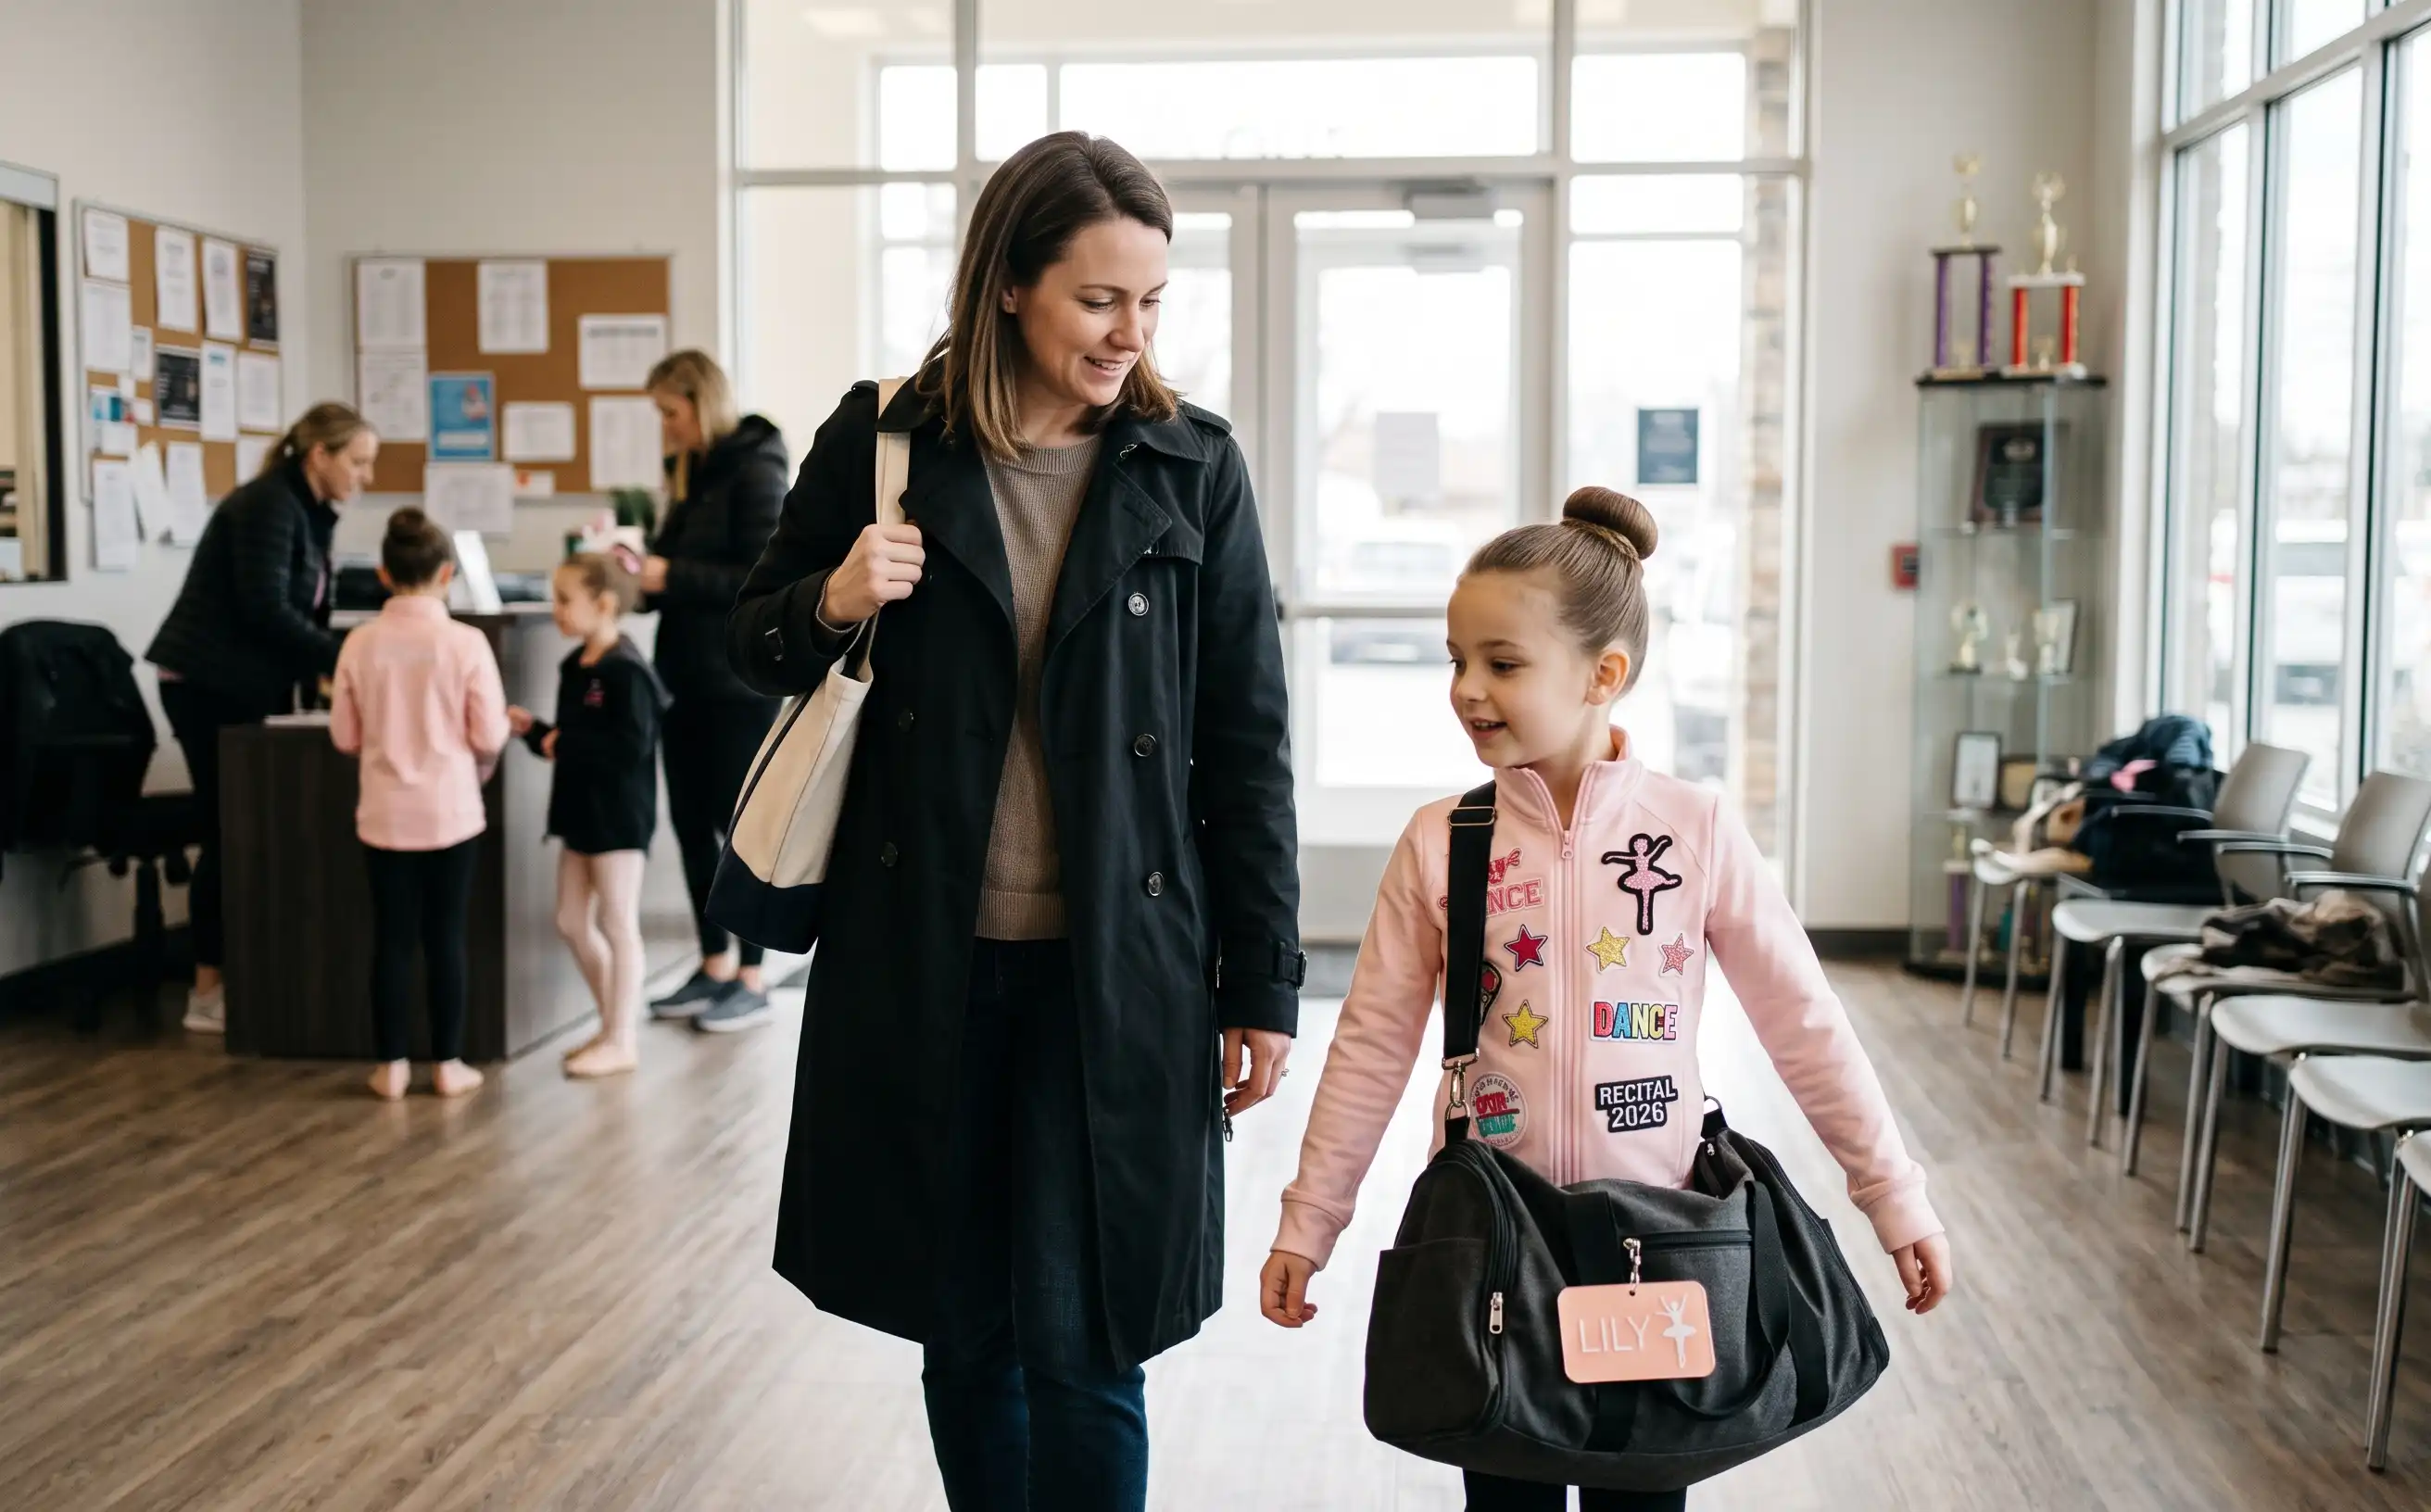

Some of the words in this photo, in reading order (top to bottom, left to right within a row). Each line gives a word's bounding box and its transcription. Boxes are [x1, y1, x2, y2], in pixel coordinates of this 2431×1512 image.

[1487, 880, 1542, 915] NCE
[1593, 1002, 1678, 1040] DANCE
[1599, 1078, 1676, 1105] RECITAL
[1611, 1102, 1665, 1128] 2026
[1579, 1315, 1650, 1354] LILY
